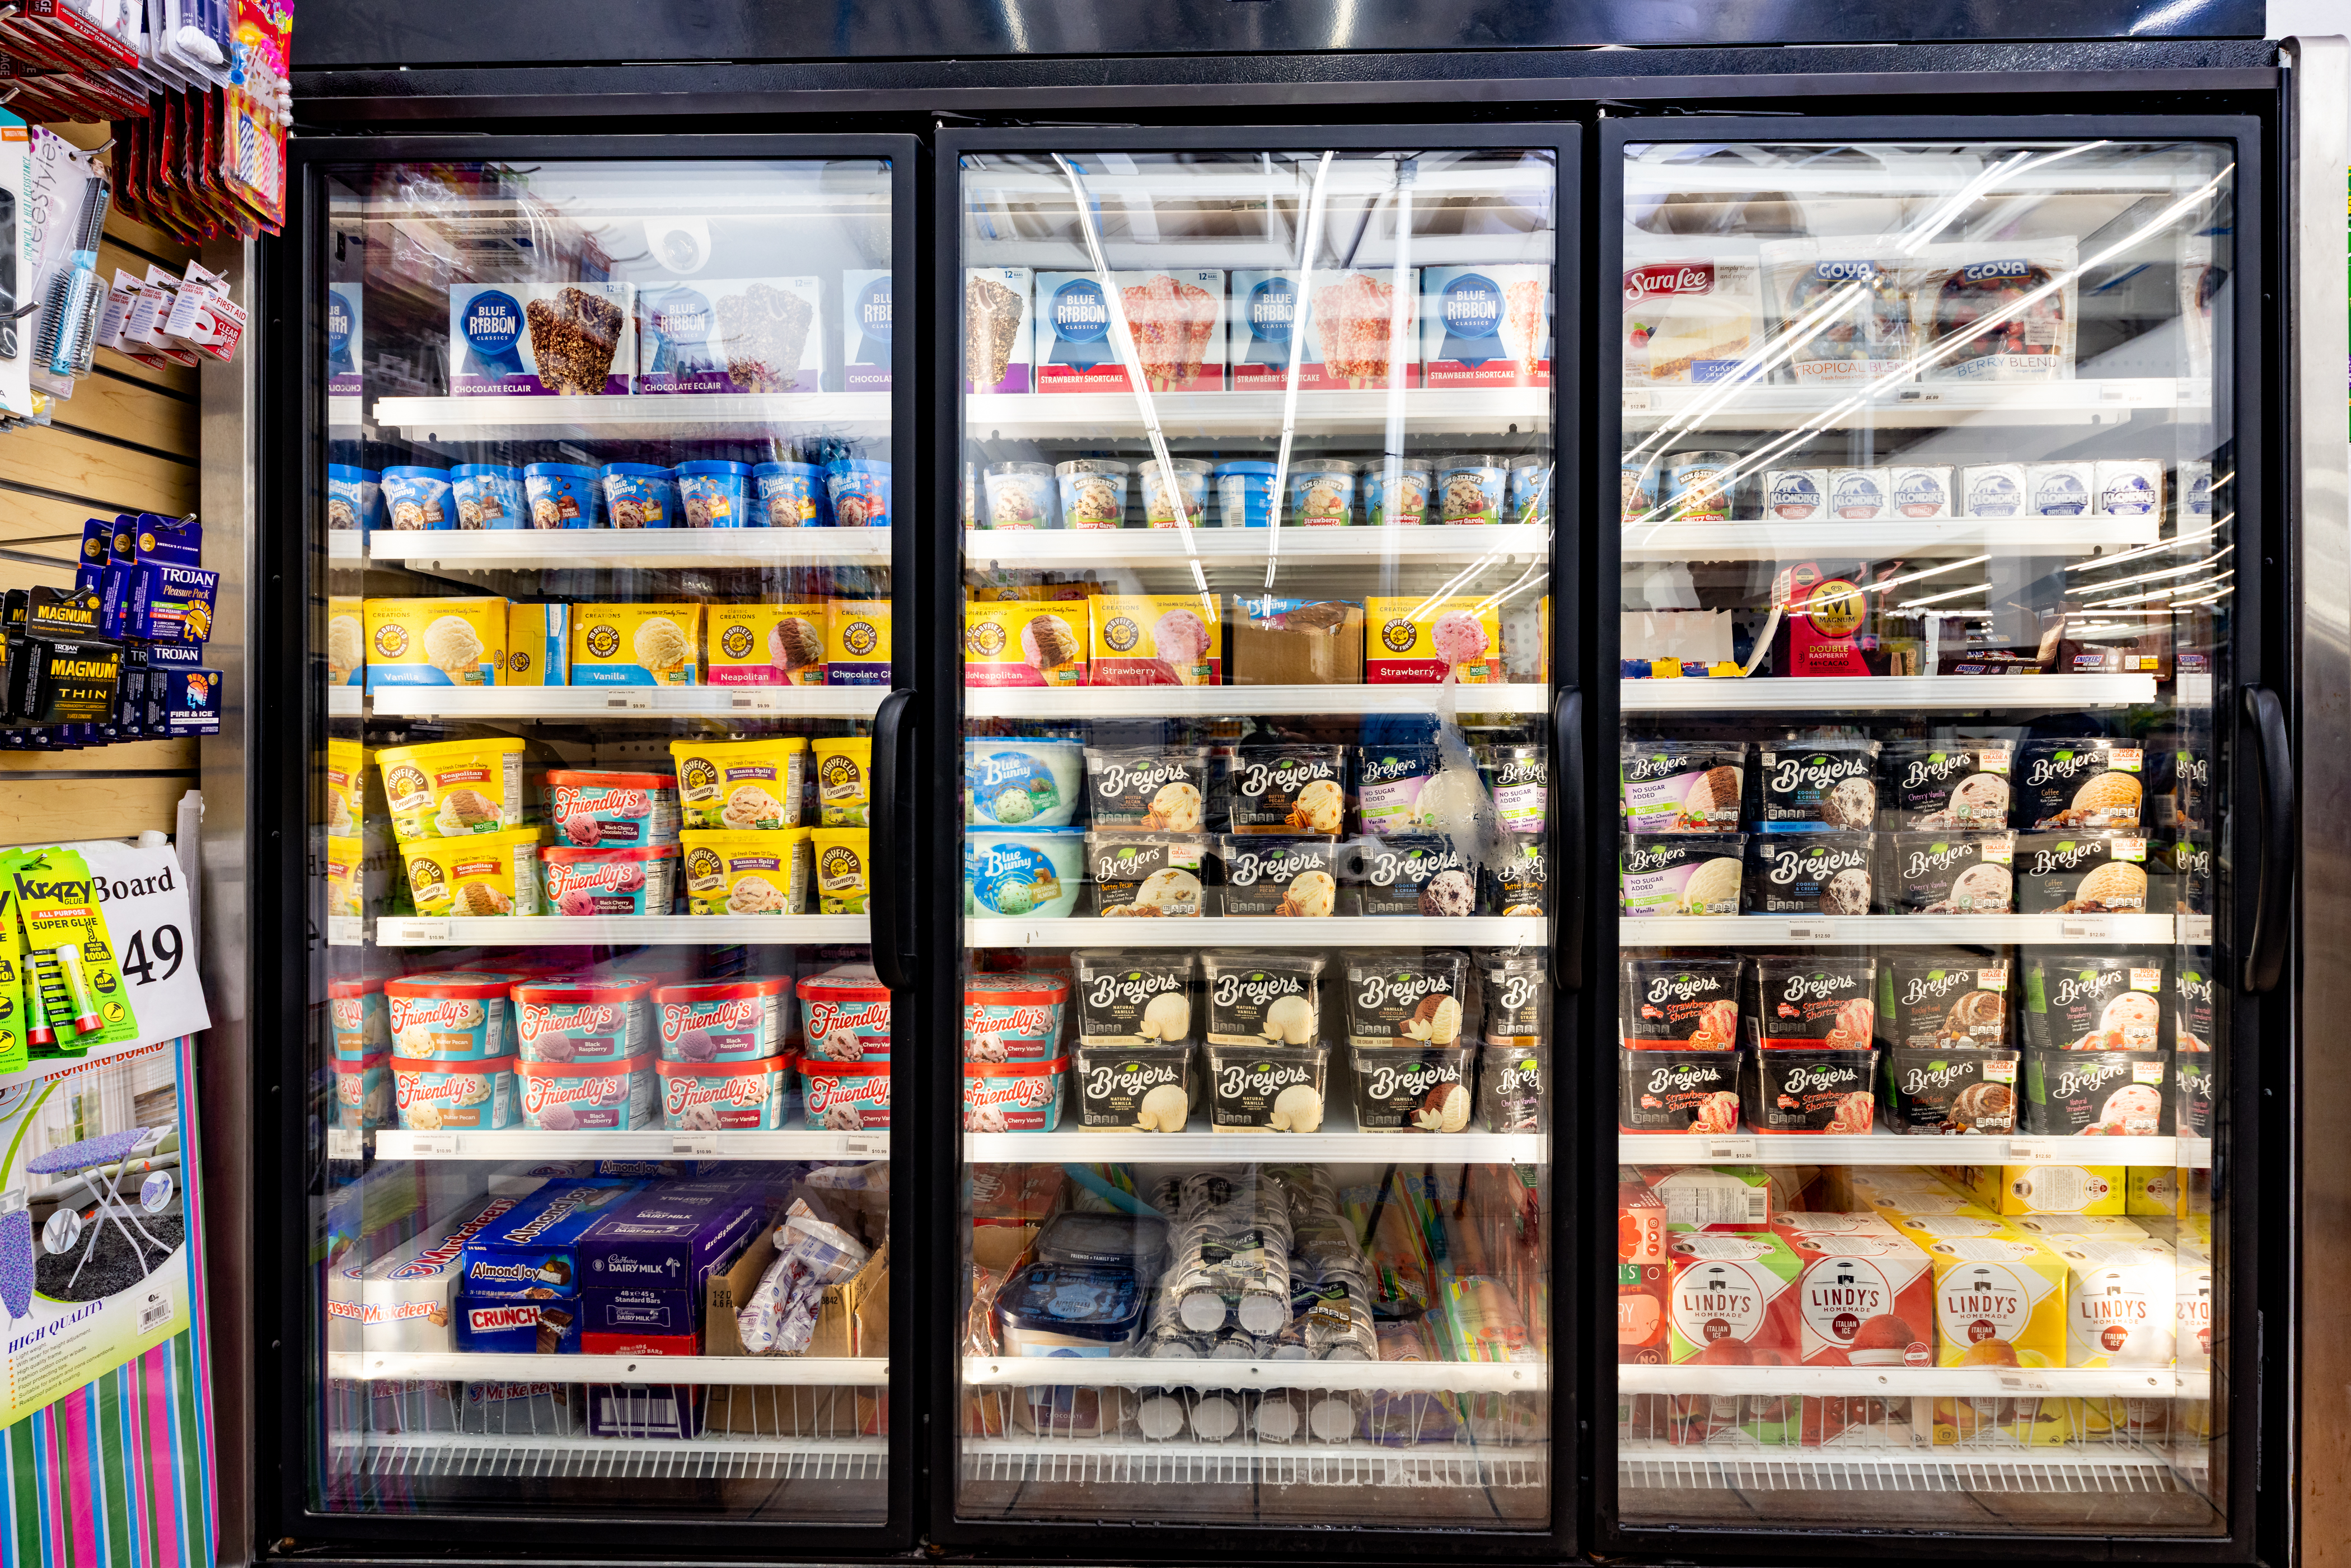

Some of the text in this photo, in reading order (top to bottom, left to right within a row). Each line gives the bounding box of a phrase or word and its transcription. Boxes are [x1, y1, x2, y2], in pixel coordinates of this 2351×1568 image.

[78, 7, 101, 26] ELBOW
[120, 36, 139, 52] WRIST
[1720, 265, 1738, 273] simply
[1732, 272, 1750, 280] enjoy!
[1818, 263, 1870, 278] GOYA
[1967, 261, 2026, 279] GOYA
[1626, 268, 1707, 300] Sara Lee
[1066, 294, 1095, 305] BLUE
[216, 297, 246, 321] FIRST AID
[478, 306, 506, 317] BLUE
[1057, 305, 1106, 324] RIBBON
[218, 322, 238, 339] CLEAR
[469, 316, 516, 335] RIBBON
[220, 332, 236, 347] TAPE
[219, 349, 230, 359] YARDS
[1795, 362, 1866, 377] TROPICAL
[1958, 357, 2057, 377] BERRY BLEND
[1041, 375, 1123, 384] STRAWBERRY SHORTCAKE
[454, 385, 502, 394] CHOCOLATE
[503, 385, 531, 393] ECLAIR
[1769, 492, 1820, 508] KLONDIKE
[2035, 492, 2088, 510] KLONDIKE
[1782, 508, 1806, 516] KRUNCH
[161, 568, 214, 586] TROJAN
[163, 584, 209, 600] Pleasure Pack
[38, 605, 92, 624] MAGNUM
[154, 648, 199, 660] TROJAN
[2073, 655, 2104, 664] SNICKERS
[51, 659, 117, 678] MAGNUM
[384, 672, 419, 681] Vanilla
[1102, 667, 1156, 677] Strawberry
[721, 673, 769, 682] Neapolitan
[59, 689, 106, 699] THIN
[441, 771, 483, 780] Neapolitan
[1903, 752, 1970, 789] Breyers
[1242, 761, 1330, 797] Breyers
[395, 791, 425, 809] Creamery
[1908, 790, 1946, 802] Cherry Vanilla
[1032, 883, 1058, 895] PISTACHIO
[1037, 890, 1057, 899] ALMOND
[32, 918, 98, 930] SUPER GLUE
[123, 924, 183, 986] 49
[1090, 973, 1182, 1008] Breyers
[1647, 977, 1721, 1003] Breyers
[1666, 1000, 1716, 1015] Strawberry
[391, 999, 470, 1035] Friendly's
[663, 1002, 752, 1042] Friendly's
[1670, 1009, 1711, 1023] Shortcake
[116, 1042, 165, 1063] BOARD
[608, 1253, 638, 1266] Cadbury
[608, 1261, 663, 1274] DAIRY MILK
[471, 1262, 541, 1281] Almond Joy
[1683, 1294, 1751, 1313] LINDY'S
[472, 1307, 539, 1328] CRUNCH
[7, 1298, 106, 1354] HIGH QUALITY
[16, 1359, 29, 1368] With
[29, 1353, 42, 1361] lever
[50, 1344, 65, 1354] height
[66, 1329, 92, 1345] adjusment.
[19, 1384, 39, 1398] Suitable
[49, 1375, 64, 1383] steam
[64, 1367, 73, 1376] and
[74, 1362, 86, 1370] irons
[86, 1345, 116, 1364] conventional.
